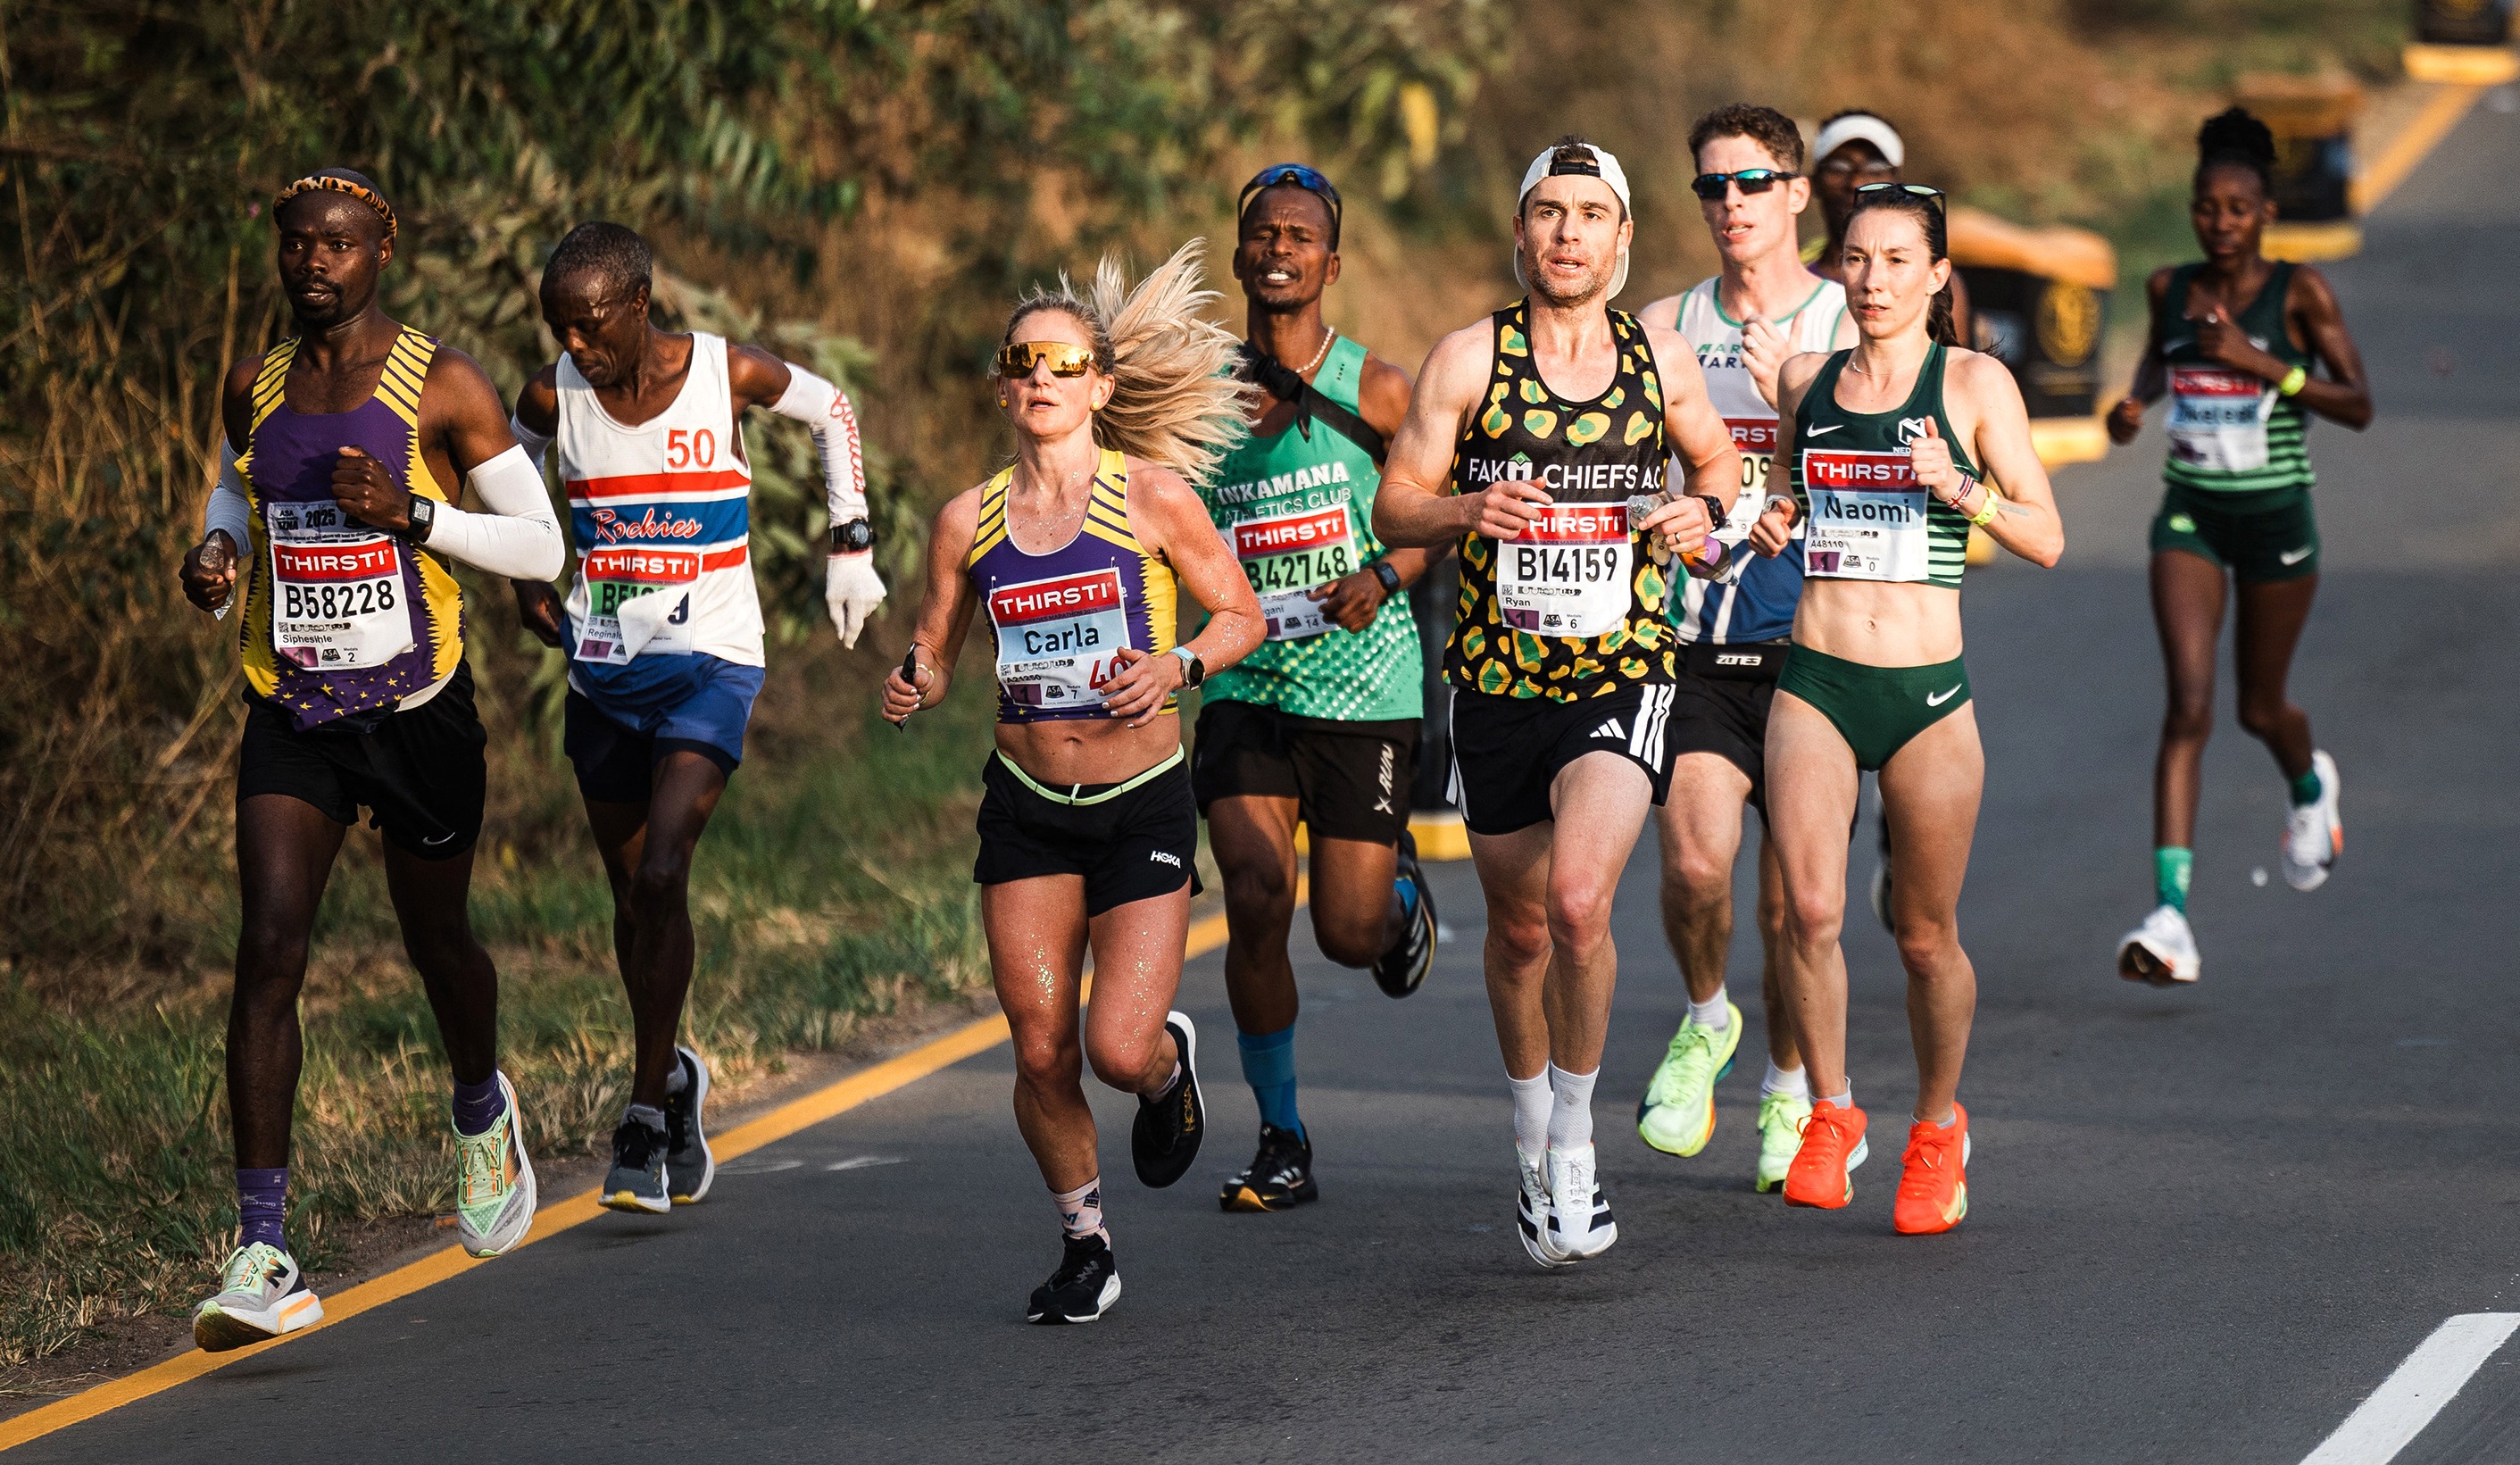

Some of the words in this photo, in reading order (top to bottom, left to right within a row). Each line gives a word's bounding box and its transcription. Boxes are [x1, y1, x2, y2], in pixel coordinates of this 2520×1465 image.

[667, 429, 715, 470] 50
[1217, 461, 1351, 505] INKAMANA
[1542, 464, 1639, 490] CHIEFS
[1308, 487, 1352, 509] CLUB
[304, 508, 337, 529] 2025
[1825, 496, 1910, 523] Naomi
[591, 506, 703, 545] Rockies
[1241, 518, 1339, 548] THIRSTI
[1528, 515, 1619, 534] HIRSTI
[1810, 540, 1844, 549] A48110
[281, 550, 385, 571] THIRSTI
[591, 556, 690, 575] THIRSTI
[1244, 546, 1349, 594] B42748
[1518, 547, 1618, 582] B14159
[285, 580, 395, 620] B58228
[997, 583, 1108, 614] THIRSTI
[1505, 596, 1531, 607] Ryan
[1264, 605, 1285, 618] gani
[1516, 611, 1526, 628] 1
[1305, 618, 1319, 628] 14
[1570, 619, 1577, 628] 6
[282, 634, 333, 645] Siphesihle
[1024, 622, 1100, 655] Carla
[293, 648, 304, 666] 1
[347, 653, 356, 662] 2
[1088, 655, 1129, 690] 40
[1019, 686, 1030, 703] 1
[1070, 689, 1077, 700] 7
[1378, 743, 1394, 796] RUN
[1150, 850, 1181, 869] HOKA
